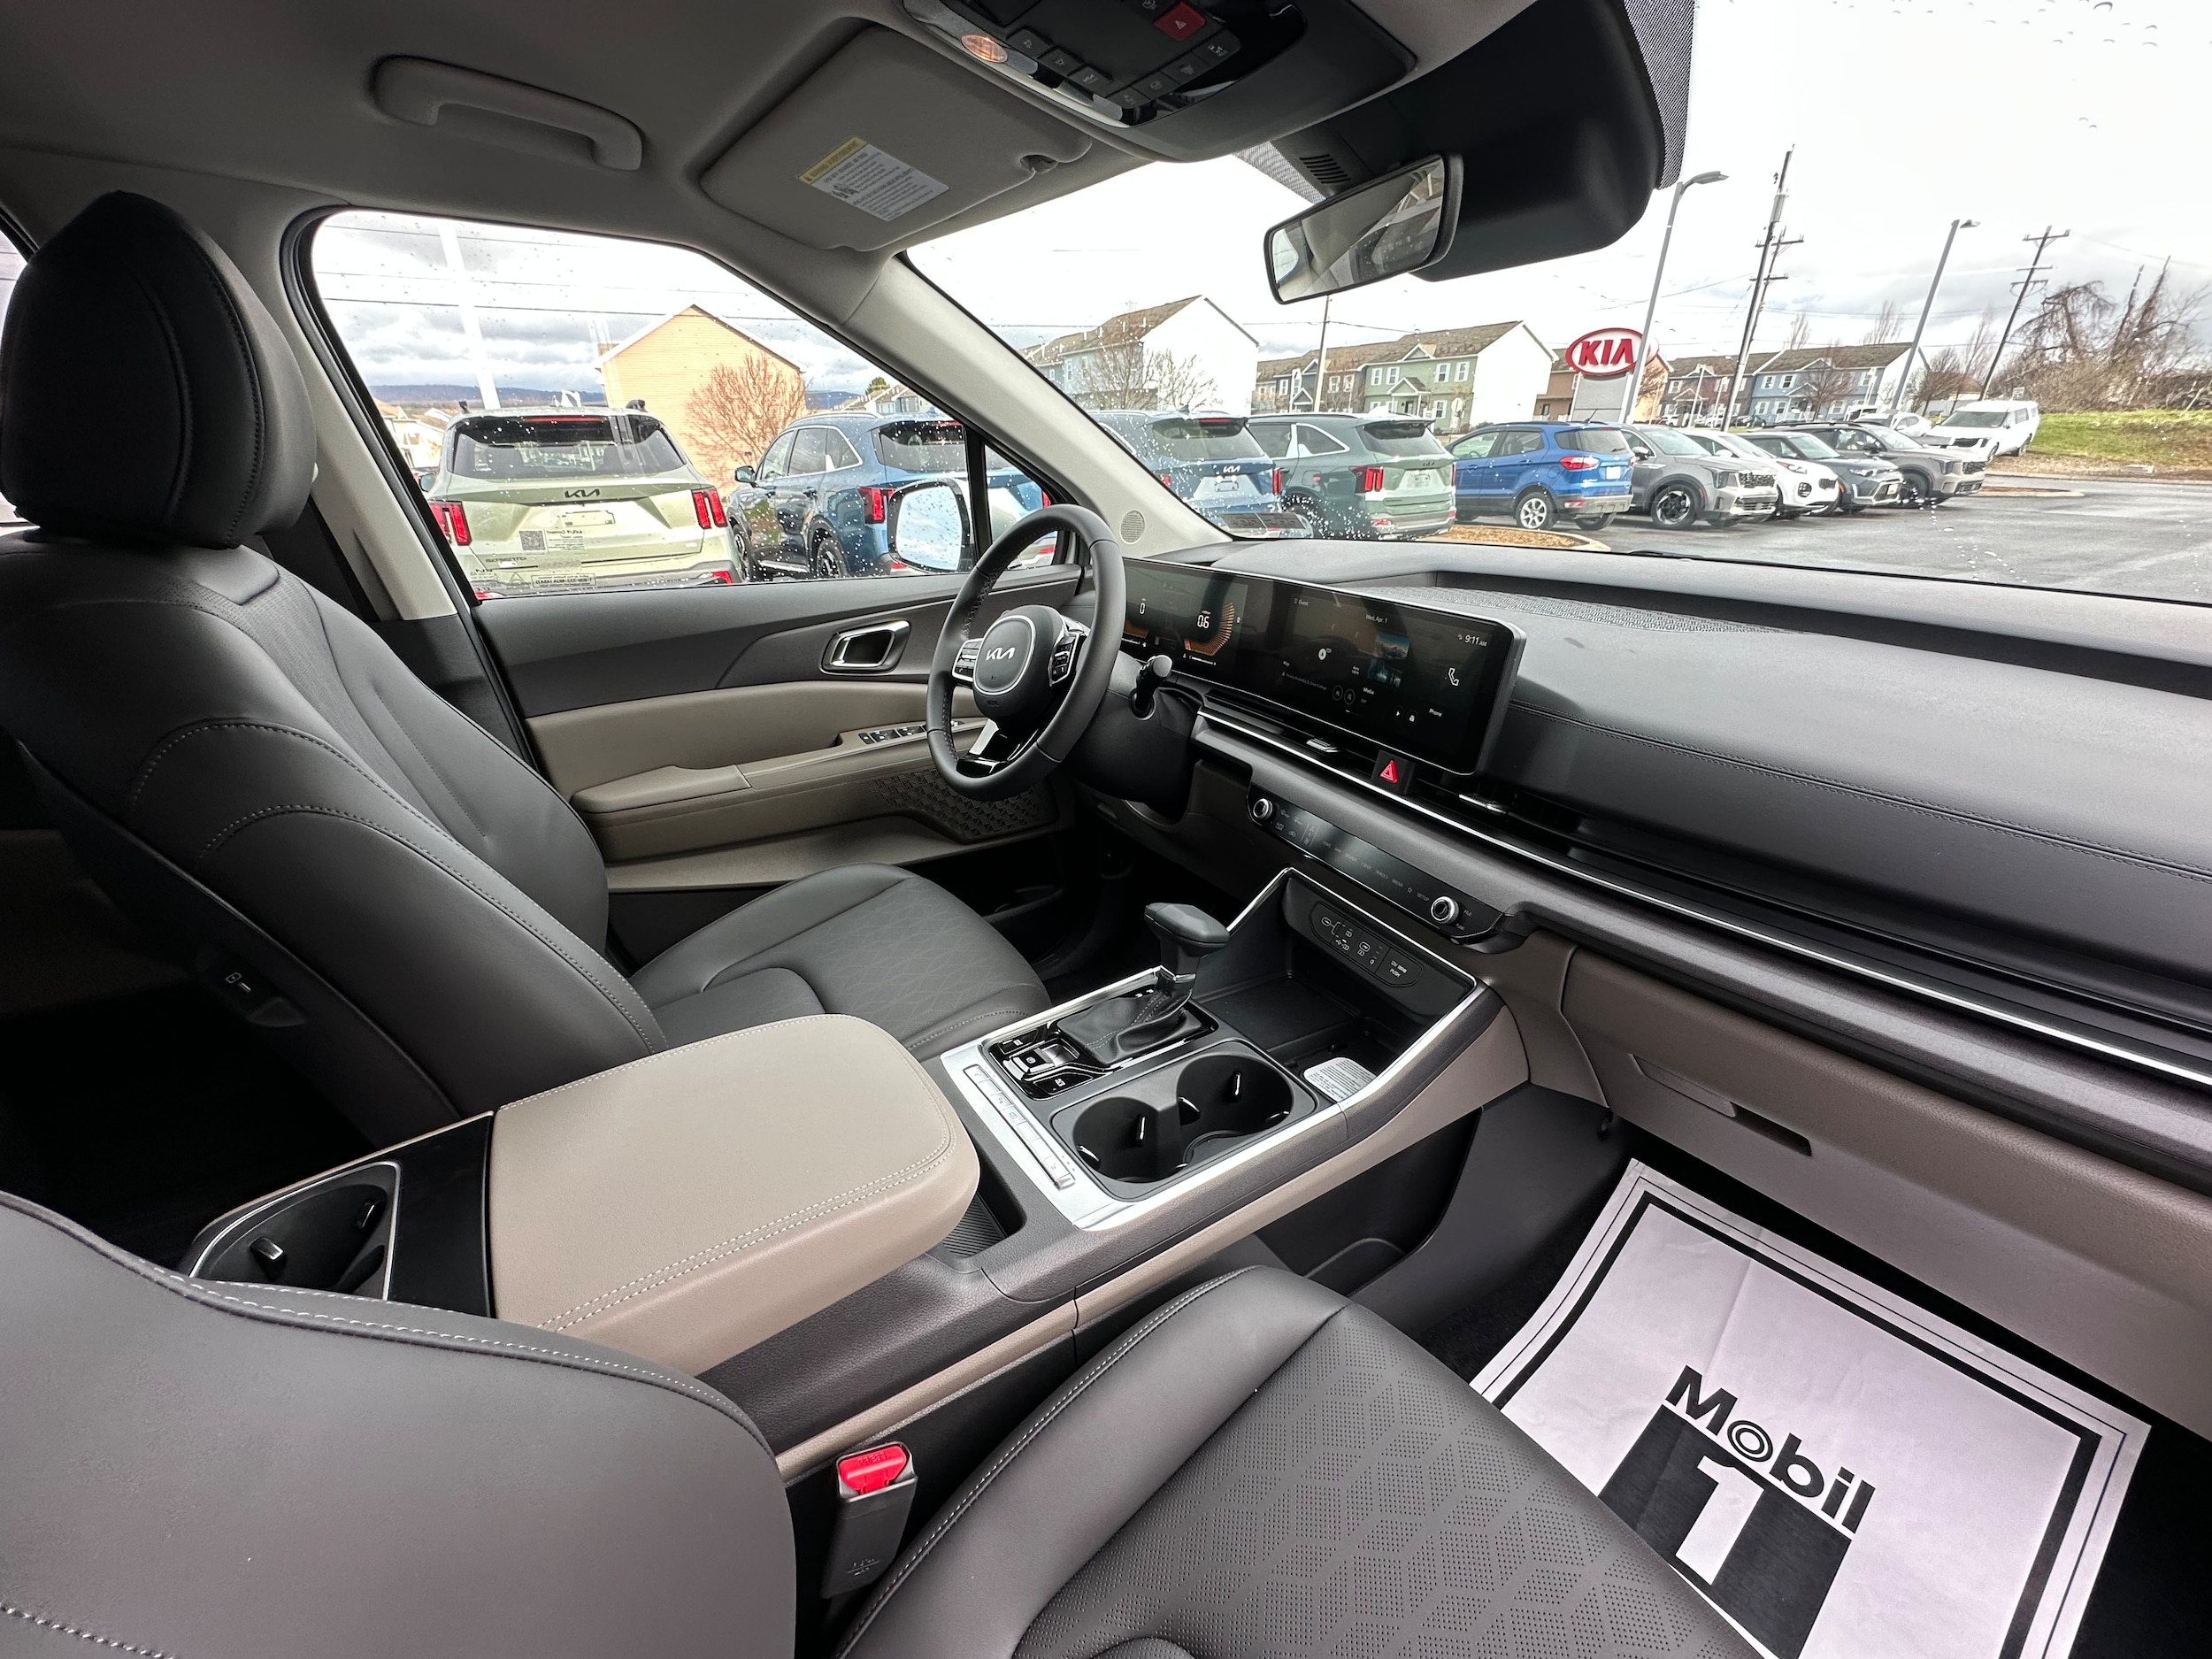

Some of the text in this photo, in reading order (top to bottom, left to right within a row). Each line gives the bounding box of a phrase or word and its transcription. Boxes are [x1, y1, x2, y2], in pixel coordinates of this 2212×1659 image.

[1578, 338, 1634, 366] KIA
[1222, 465, 1241, 473] KIA
[565, 488, 600, 498] KIA
[1139, 603, 1146, 615] 0
[1464, 634, 1479, 645] 9:11
[986, 647, 1016, 661] KIA
[1429, 708, 1442, 718] Phone
[1664, 1364, 1877, 1535] Mobil
[1675, 1455, 1765, 1586] 1
